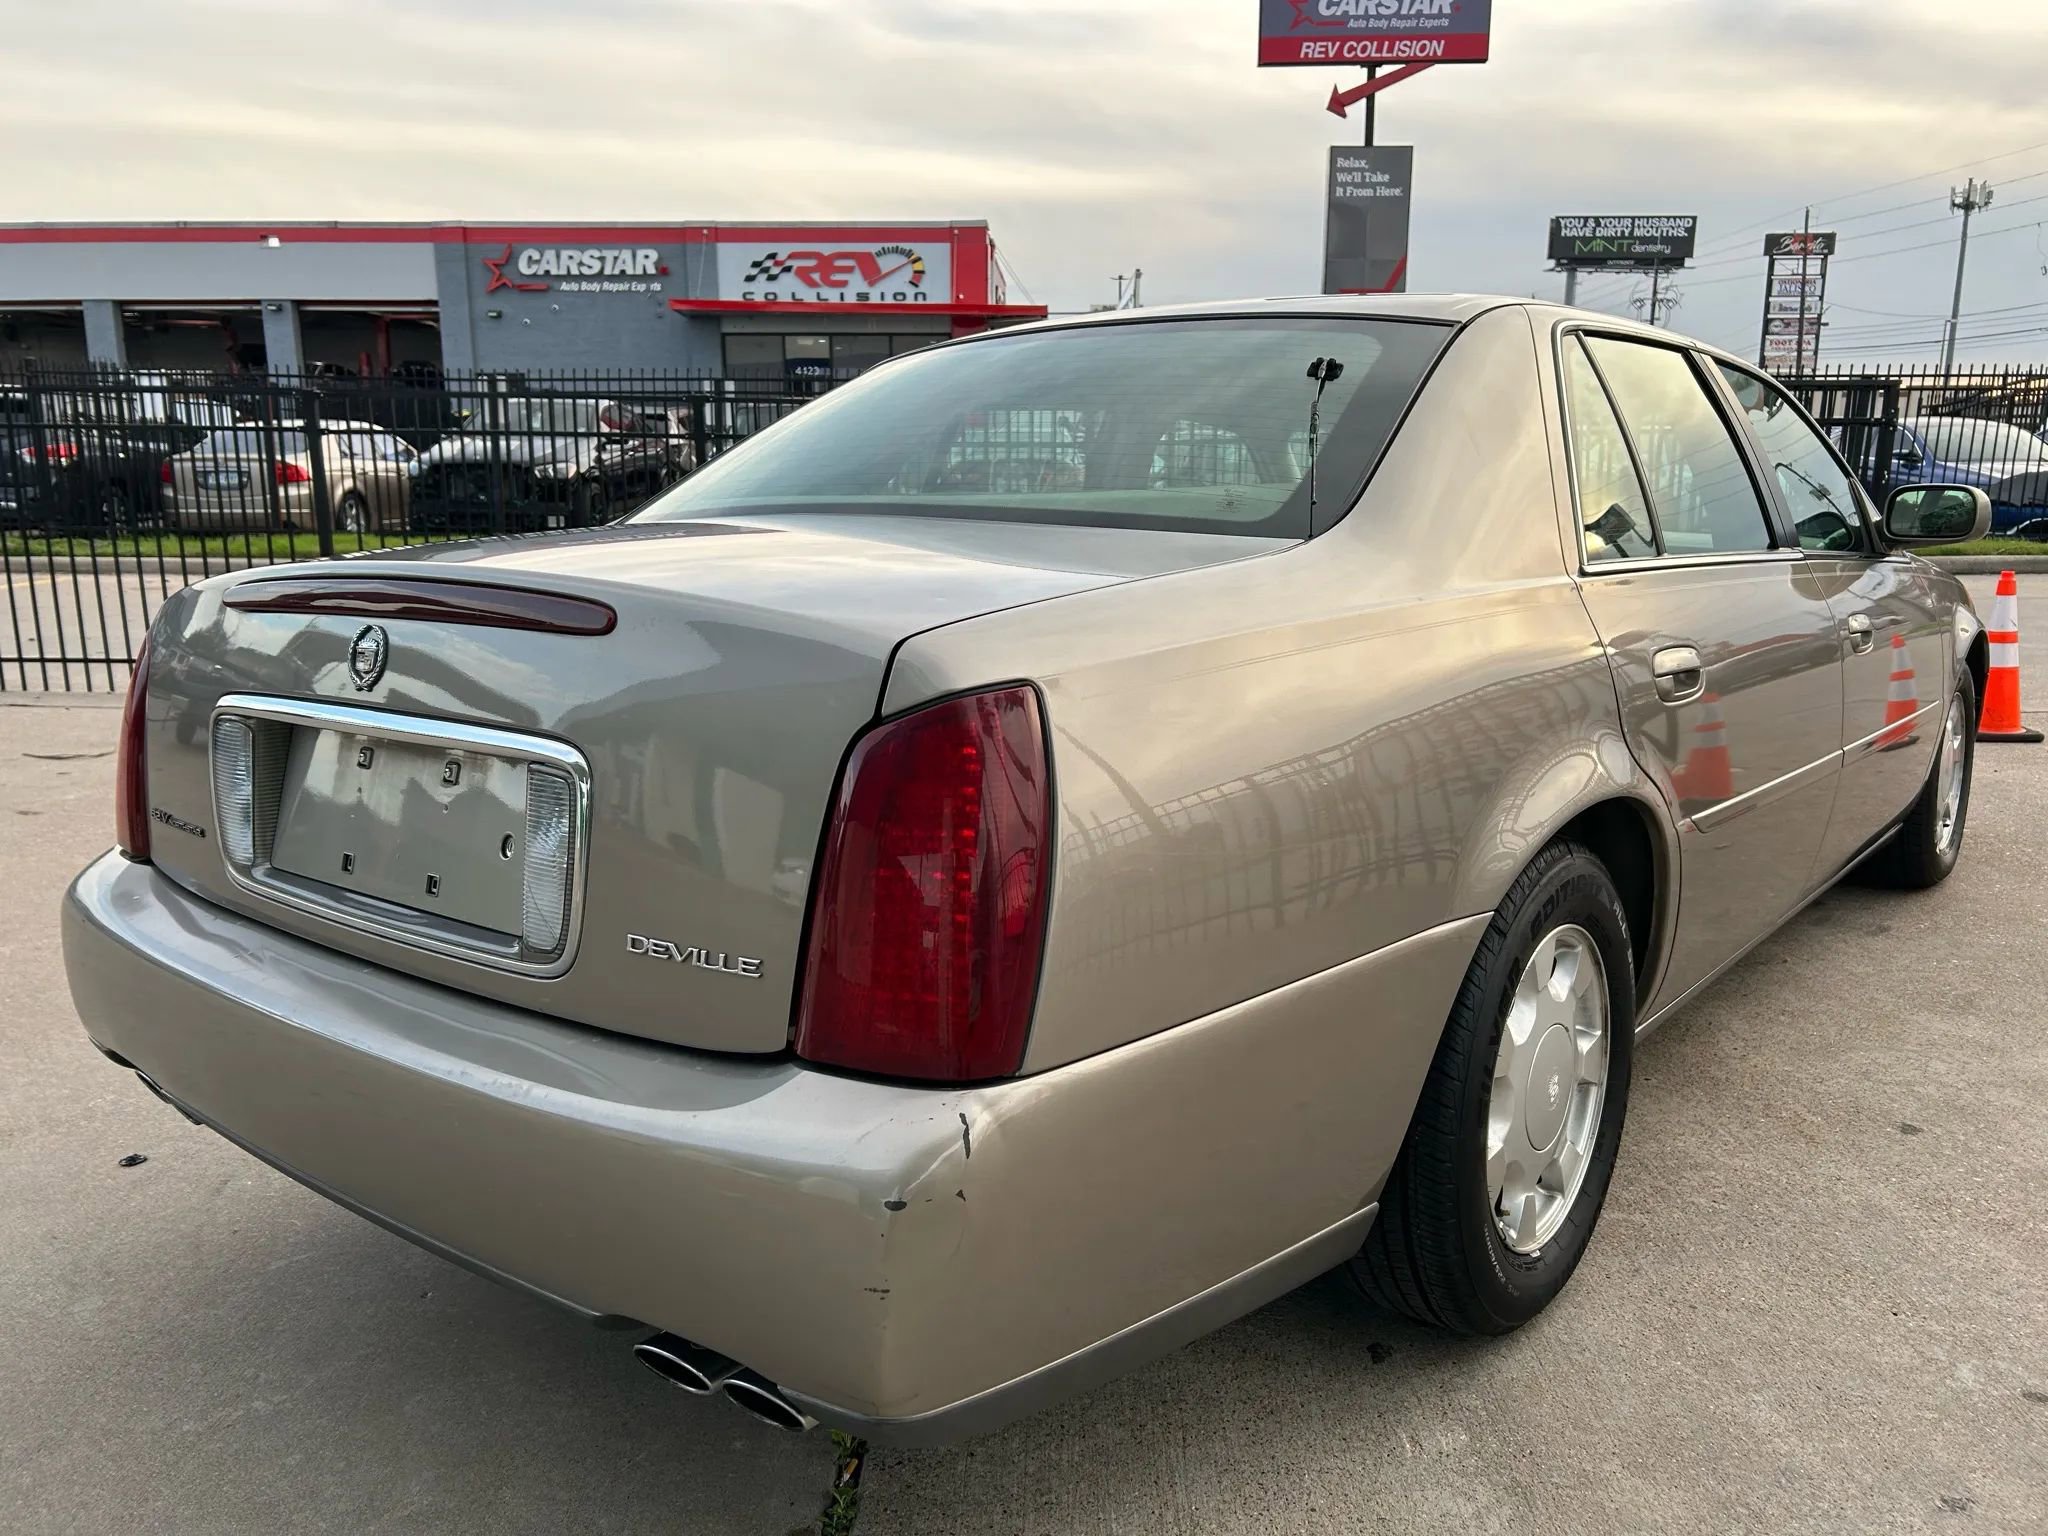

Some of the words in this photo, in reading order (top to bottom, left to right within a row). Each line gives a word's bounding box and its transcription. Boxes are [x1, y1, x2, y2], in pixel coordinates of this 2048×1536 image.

[1347, 18, 1367, 28] Auto
[1368, 18, 1388, 29] Body
[1389, 18, 1418, 29] Repair
[1419, 17, 1450, 28] Experts
[1300, 41, 1340, 58] REV
[1343, 40, 1446, 58] COLLISION
[1336, 157, 1369, 169] Relax,
[1336, 171, 1362, 183] We'll
[1363, 171, 1390, 183] Take
[1335, 186, 1344, 197] It
[1346, 186, 1374, 197] From
[1558, 217, 1584, 228] YOU
[1586, 217, 1596, 228] &
[1598, 217, 1633, 228] YOUR
[1634, 217, 1693, 228] HUSBAND
[1560, 227, 1594, 237] HAVE
[1595, 227, 1632, 237] DIRTY
[1631, 241, 1671, 254] dentistry
[517, 248, 659, 276] CARSTAR
[778, 251, 917, 288] REV
[560, 281, 580, 291] Auto
[580, 281, 601, 293] Body
[602, 281, 629, 293] Repair
[626, 933, 763, 979] DEVILLE
